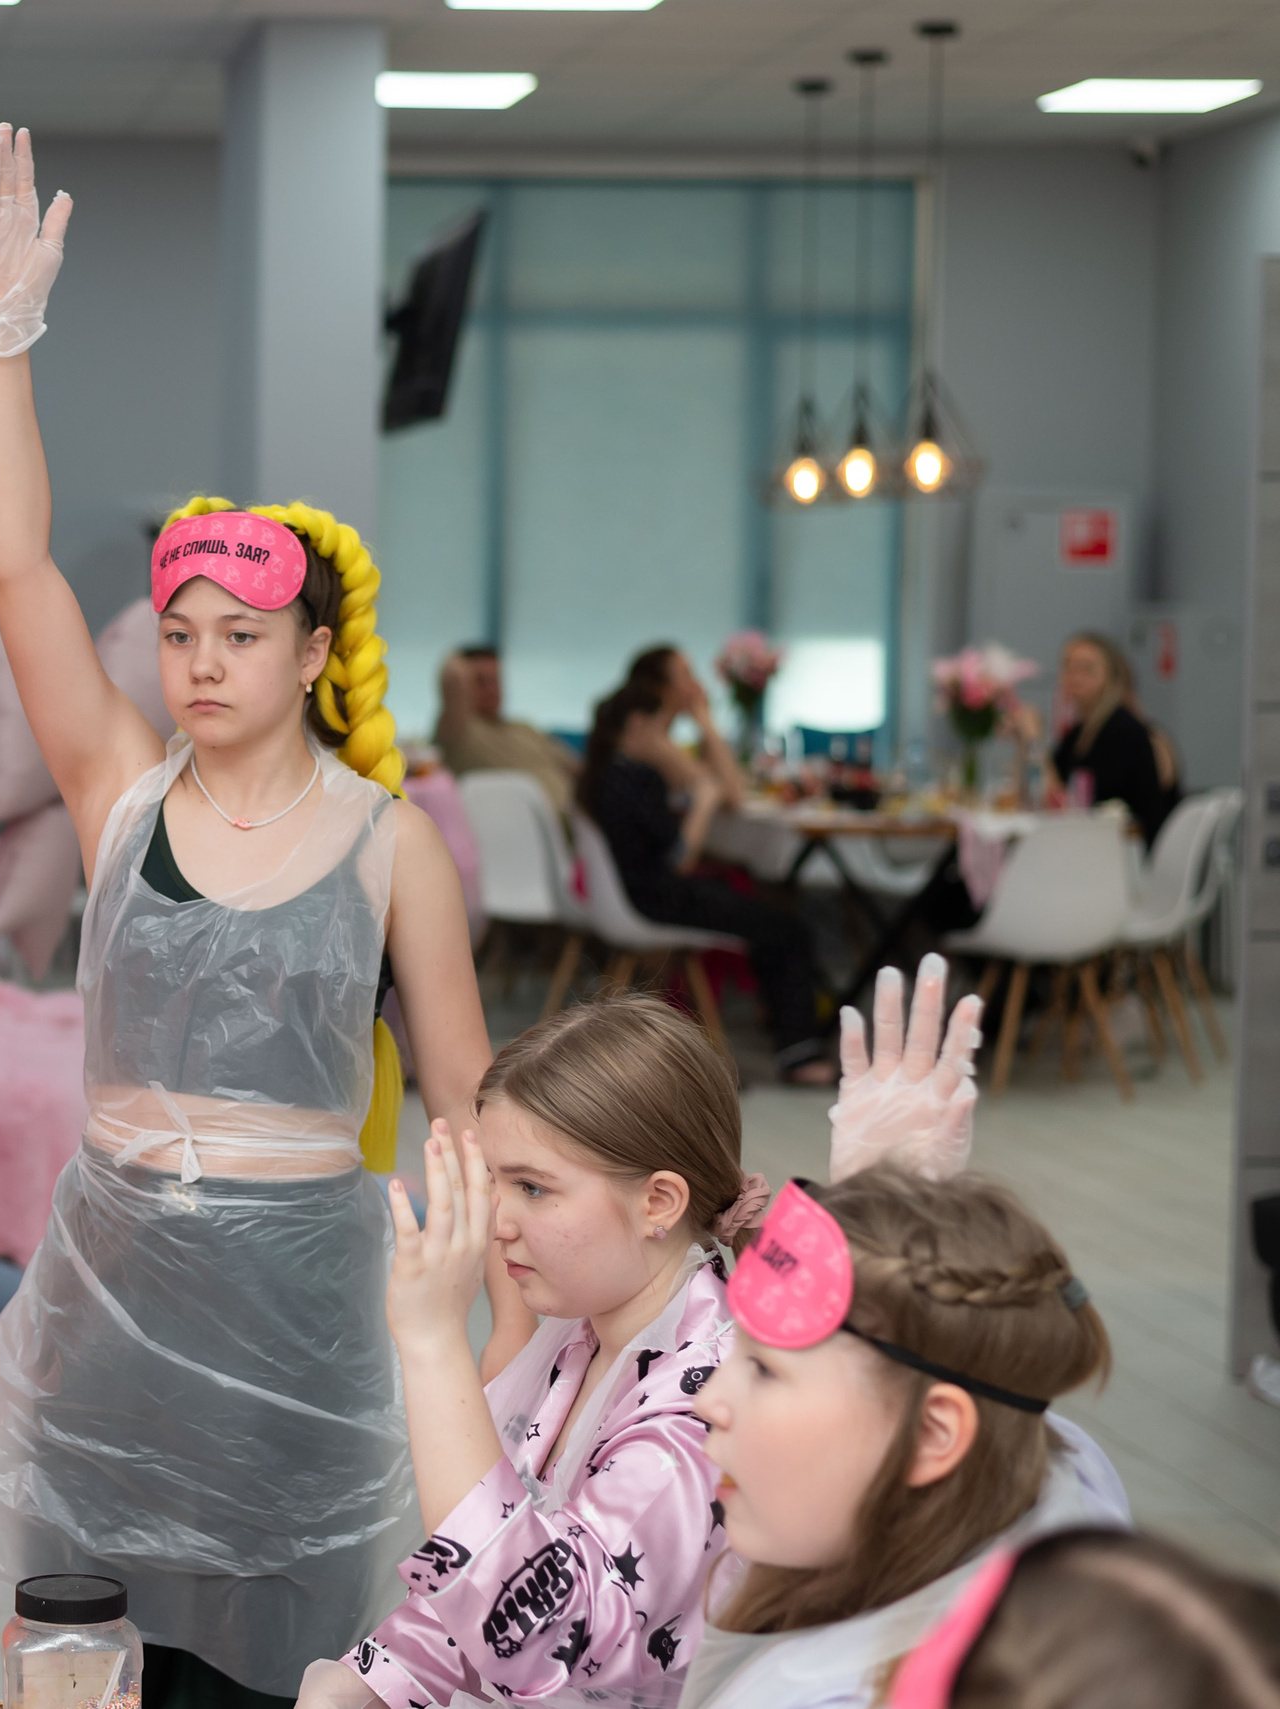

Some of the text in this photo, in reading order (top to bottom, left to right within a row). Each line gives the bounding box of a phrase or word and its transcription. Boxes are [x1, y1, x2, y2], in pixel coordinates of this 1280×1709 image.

[169, 545, 182, 564] НЕ
[183, 539, 231, 557] СПИШЬ,
[235, 542, 270, 566] ЗАЯ?
